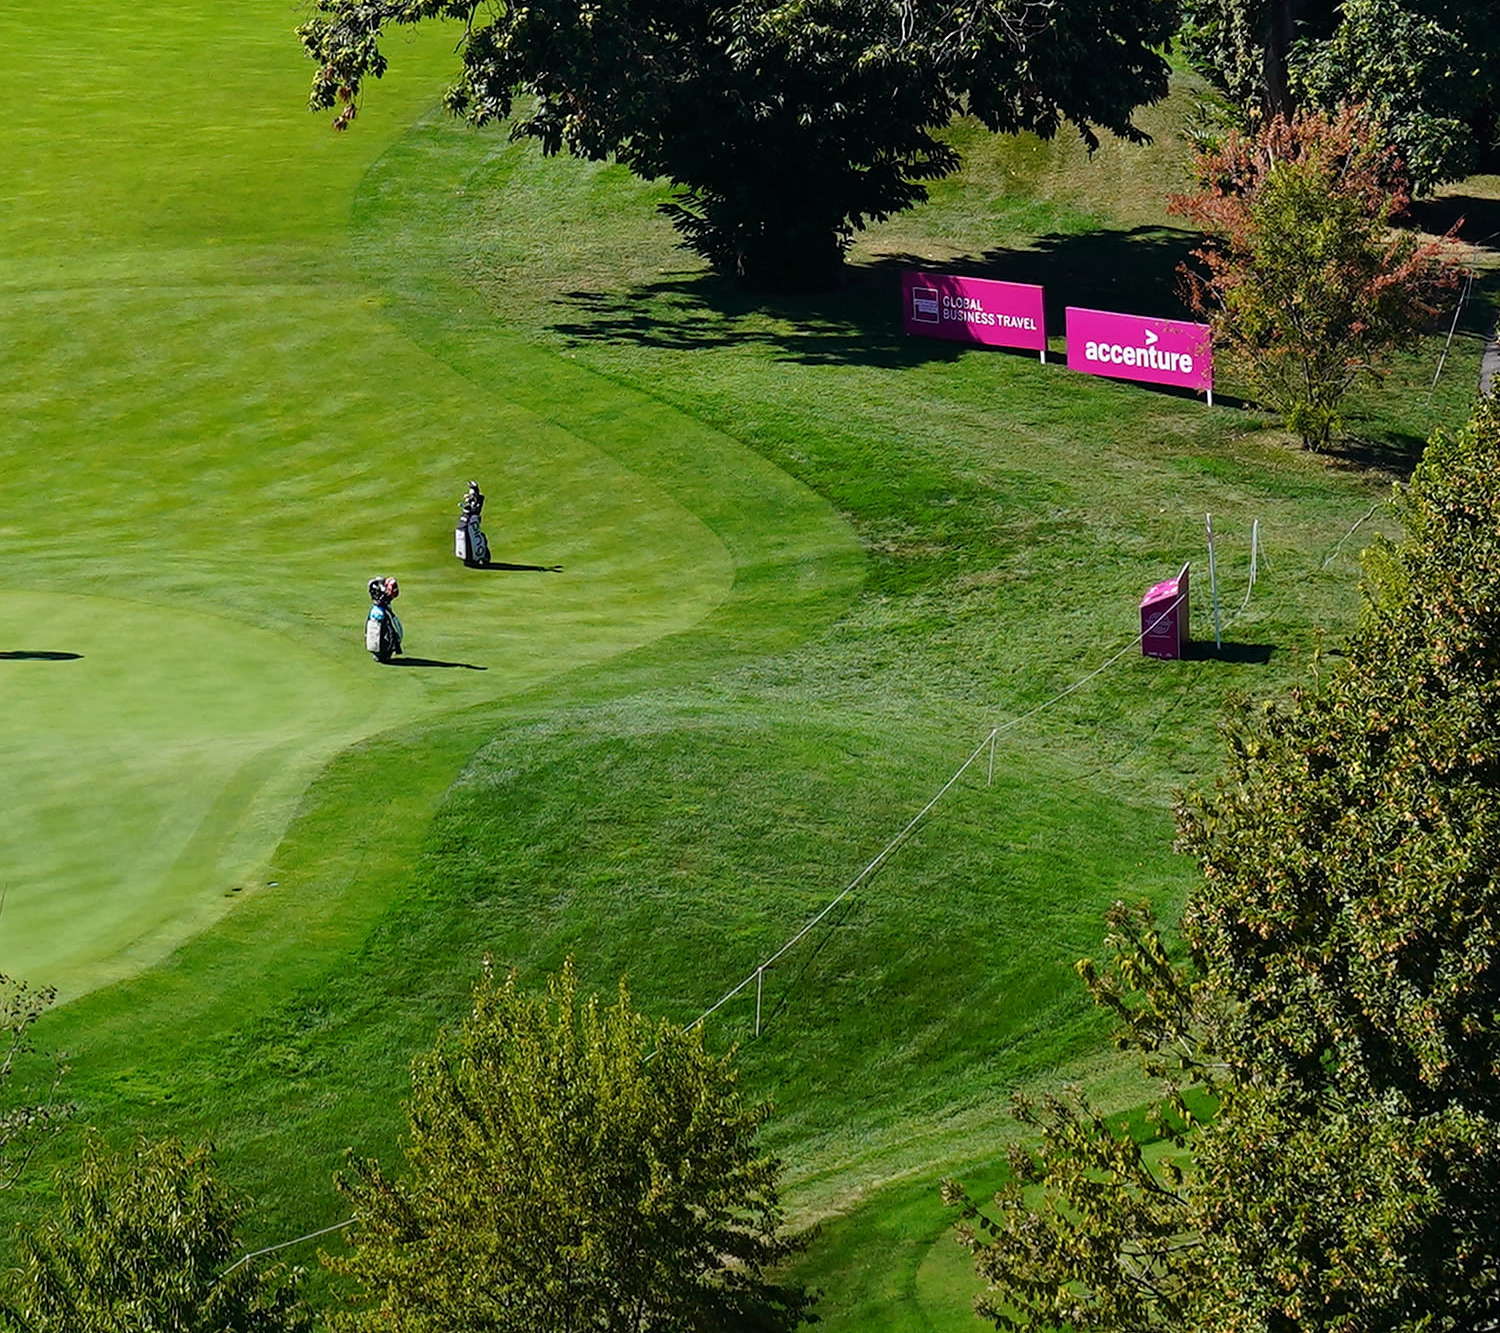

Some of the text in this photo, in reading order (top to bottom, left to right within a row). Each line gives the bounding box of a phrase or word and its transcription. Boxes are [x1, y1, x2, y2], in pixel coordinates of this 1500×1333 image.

[943, 296, 983, 311] GLOBAL
[943, 308, 1037, 331] BUSINESS TRAVEL
[1085, 341, 1193, 373] accenture
